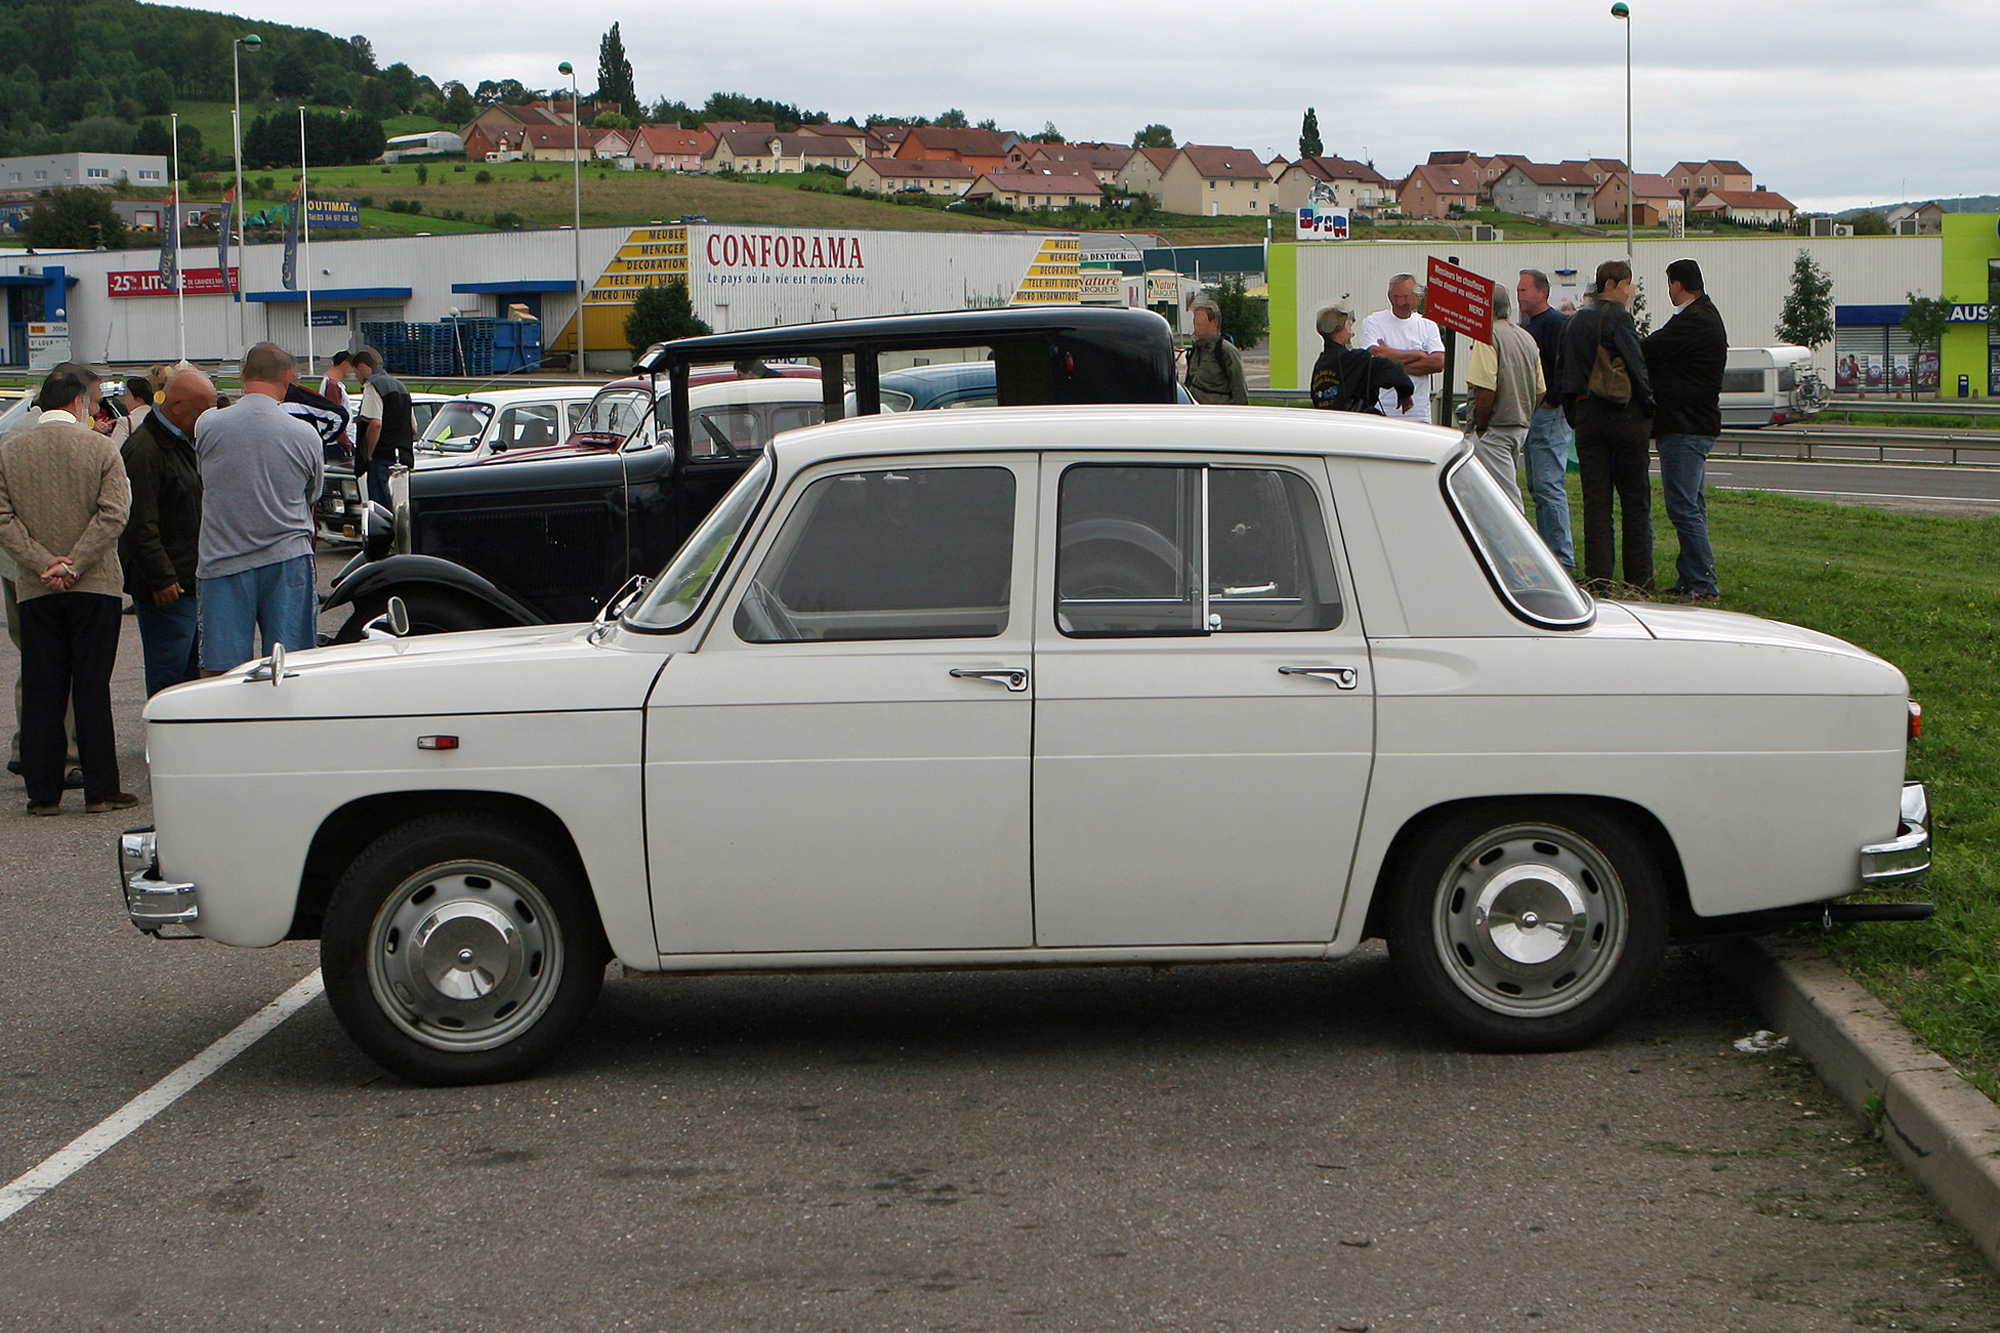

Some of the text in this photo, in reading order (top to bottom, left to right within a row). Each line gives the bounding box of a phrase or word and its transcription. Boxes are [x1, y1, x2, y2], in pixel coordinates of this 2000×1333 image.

[308, 200, 350, 212] OUTIMAT
[649, 229, 685, 240] MEUBLE
[641, 244, 685, 254] MENAGER
[707, 234, 864, 268] CONFORAMA
[1090, 252, 1127, 261] DESTOCK
[627, 259, 685, 270] DECORATION
[110, 275, 137, 292] -25%
[609, 275, 630, 285] TELE
[634, 275, 653, 285] HIFI
[707, 272, 865, 287] Le pays où la vie est moins chère
[591, 290, 619, 300] MICRO
